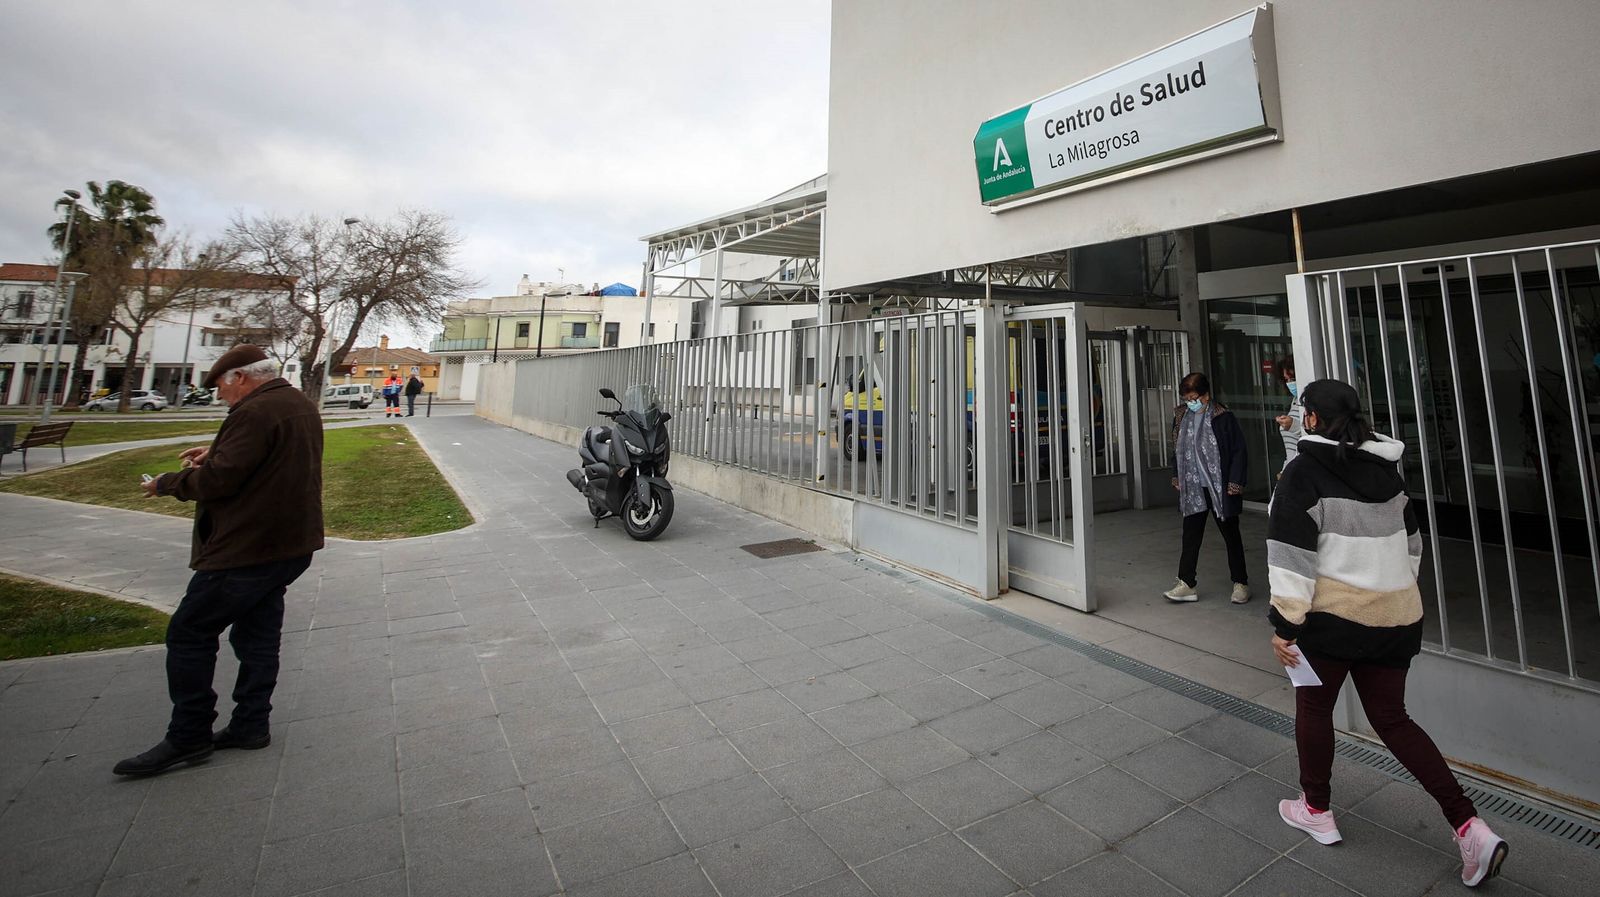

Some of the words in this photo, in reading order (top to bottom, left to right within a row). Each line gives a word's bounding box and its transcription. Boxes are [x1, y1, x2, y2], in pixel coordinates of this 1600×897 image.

[1044, 104, 1105, 139] Centro
[1110, 92, 1135, 117] de
[1140, 61, 1207, 106] Salud
[1048, 150, 1065, 169] La
[1066, 129, 1140, 163] Milagrosa
[983, 176, 996, 185] Junta
[996, 173, 1003, 181] de
[1002, 165, 1026, 179] Andalucía
